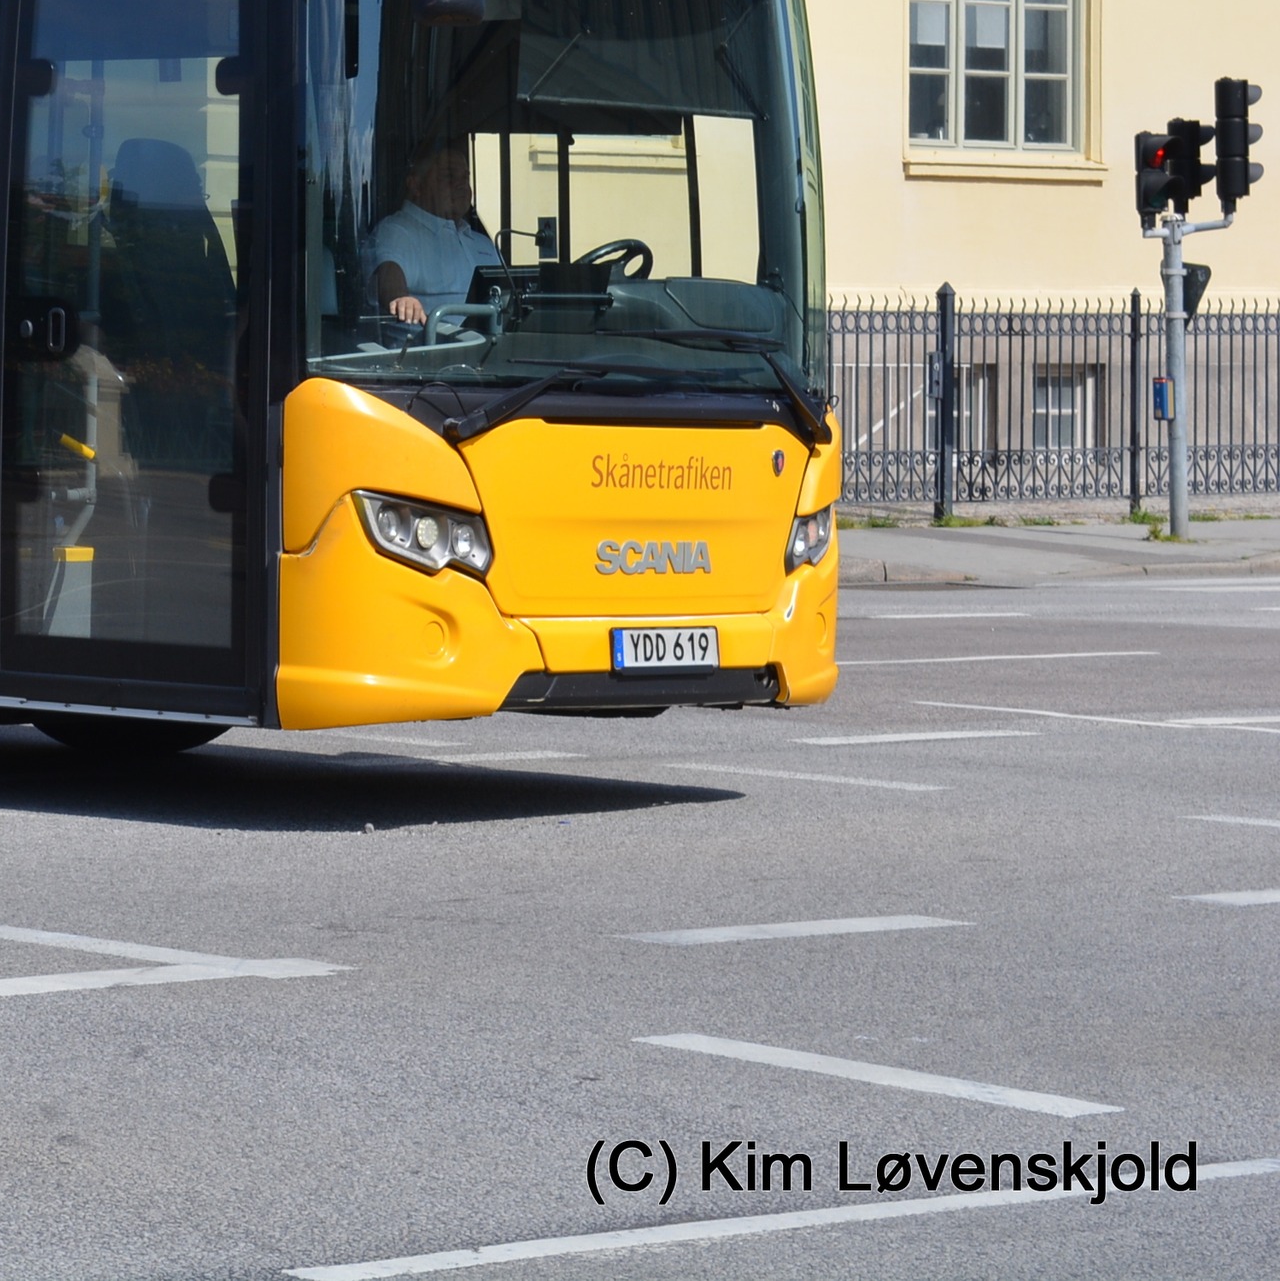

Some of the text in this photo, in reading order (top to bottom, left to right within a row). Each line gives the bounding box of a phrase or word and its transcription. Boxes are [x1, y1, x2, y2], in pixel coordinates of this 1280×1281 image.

[591, 453, 732, 490] Skånetrafiken
[595, 540, 711, 575] SCANIA
[630, 632, 666, 662] YDD
[673, 632, 709, 662] 619
